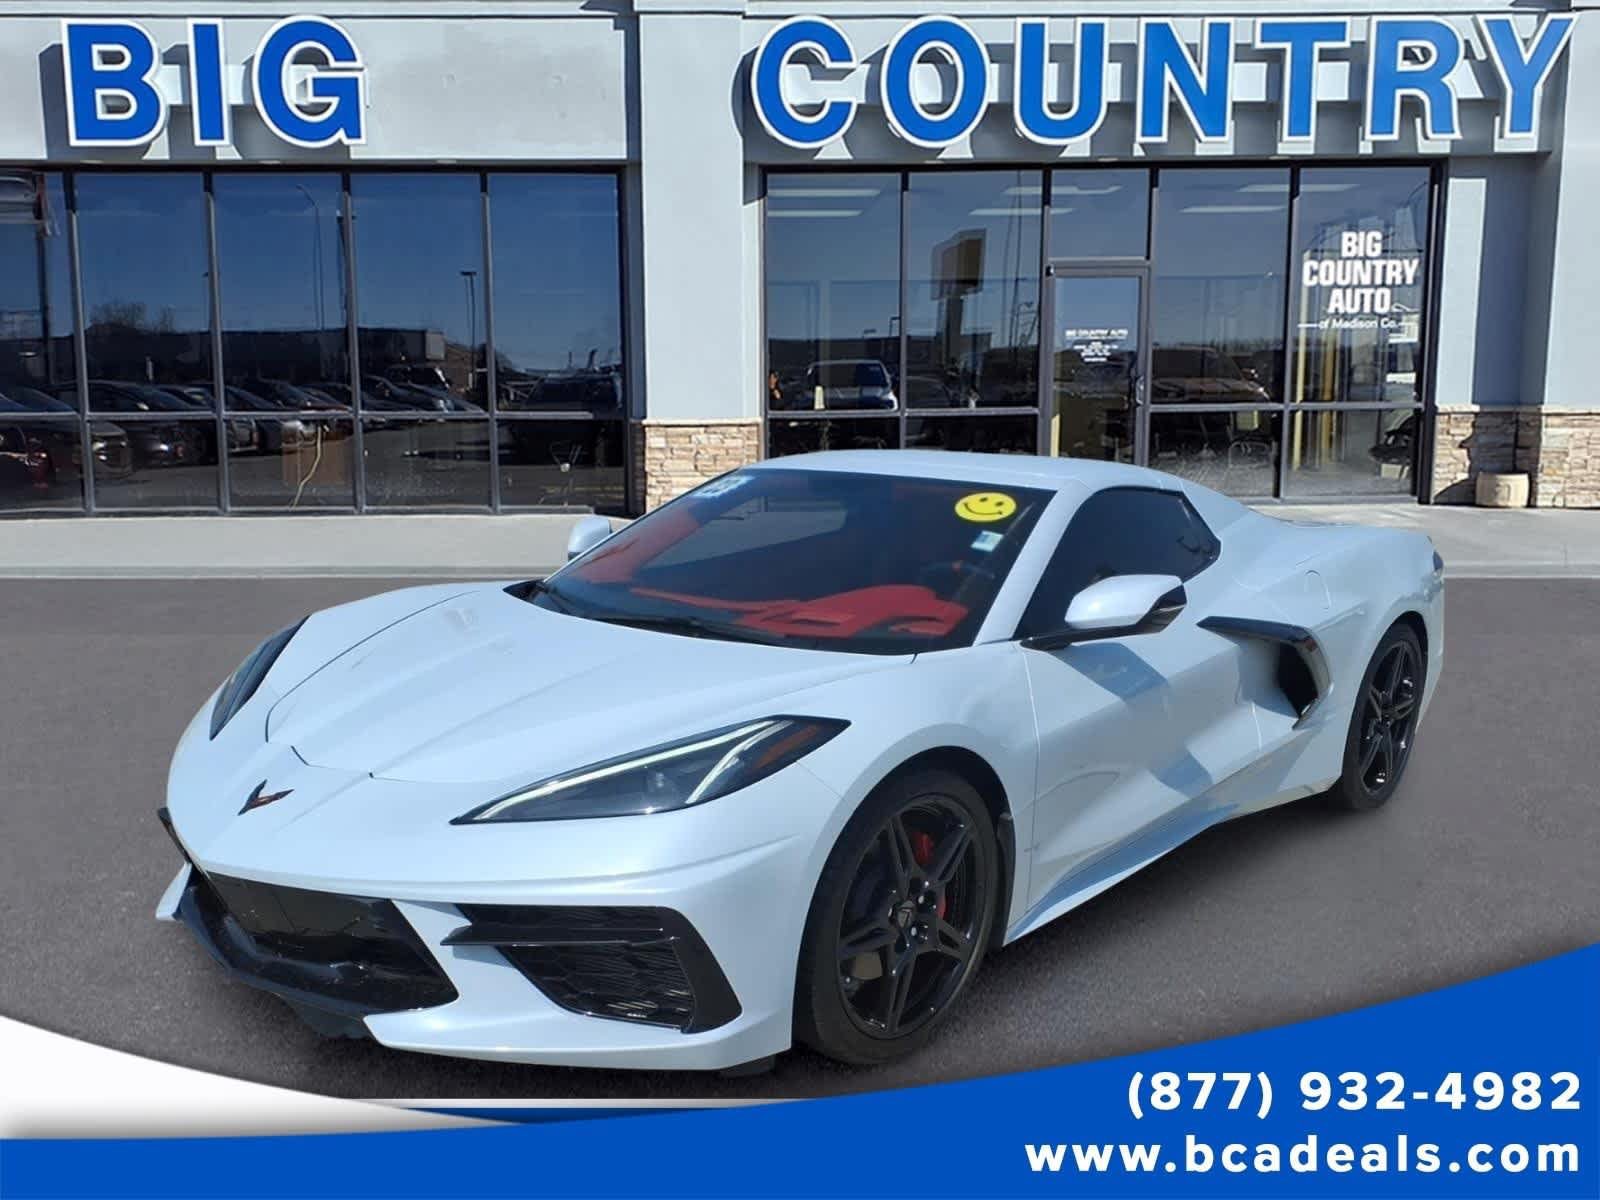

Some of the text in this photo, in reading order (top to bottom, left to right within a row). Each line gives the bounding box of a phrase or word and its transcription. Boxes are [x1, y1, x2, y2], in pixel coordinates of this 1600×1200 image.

[62, 14, 1576, 149] BIG COUNTRY
[1341, 231, 1382, 258] BIG
[1303, 259, 1420, 286] COUNTRY
[1327, 288, 1392, 314] AUTO
[1331, 318, 1378, 329] Madison
